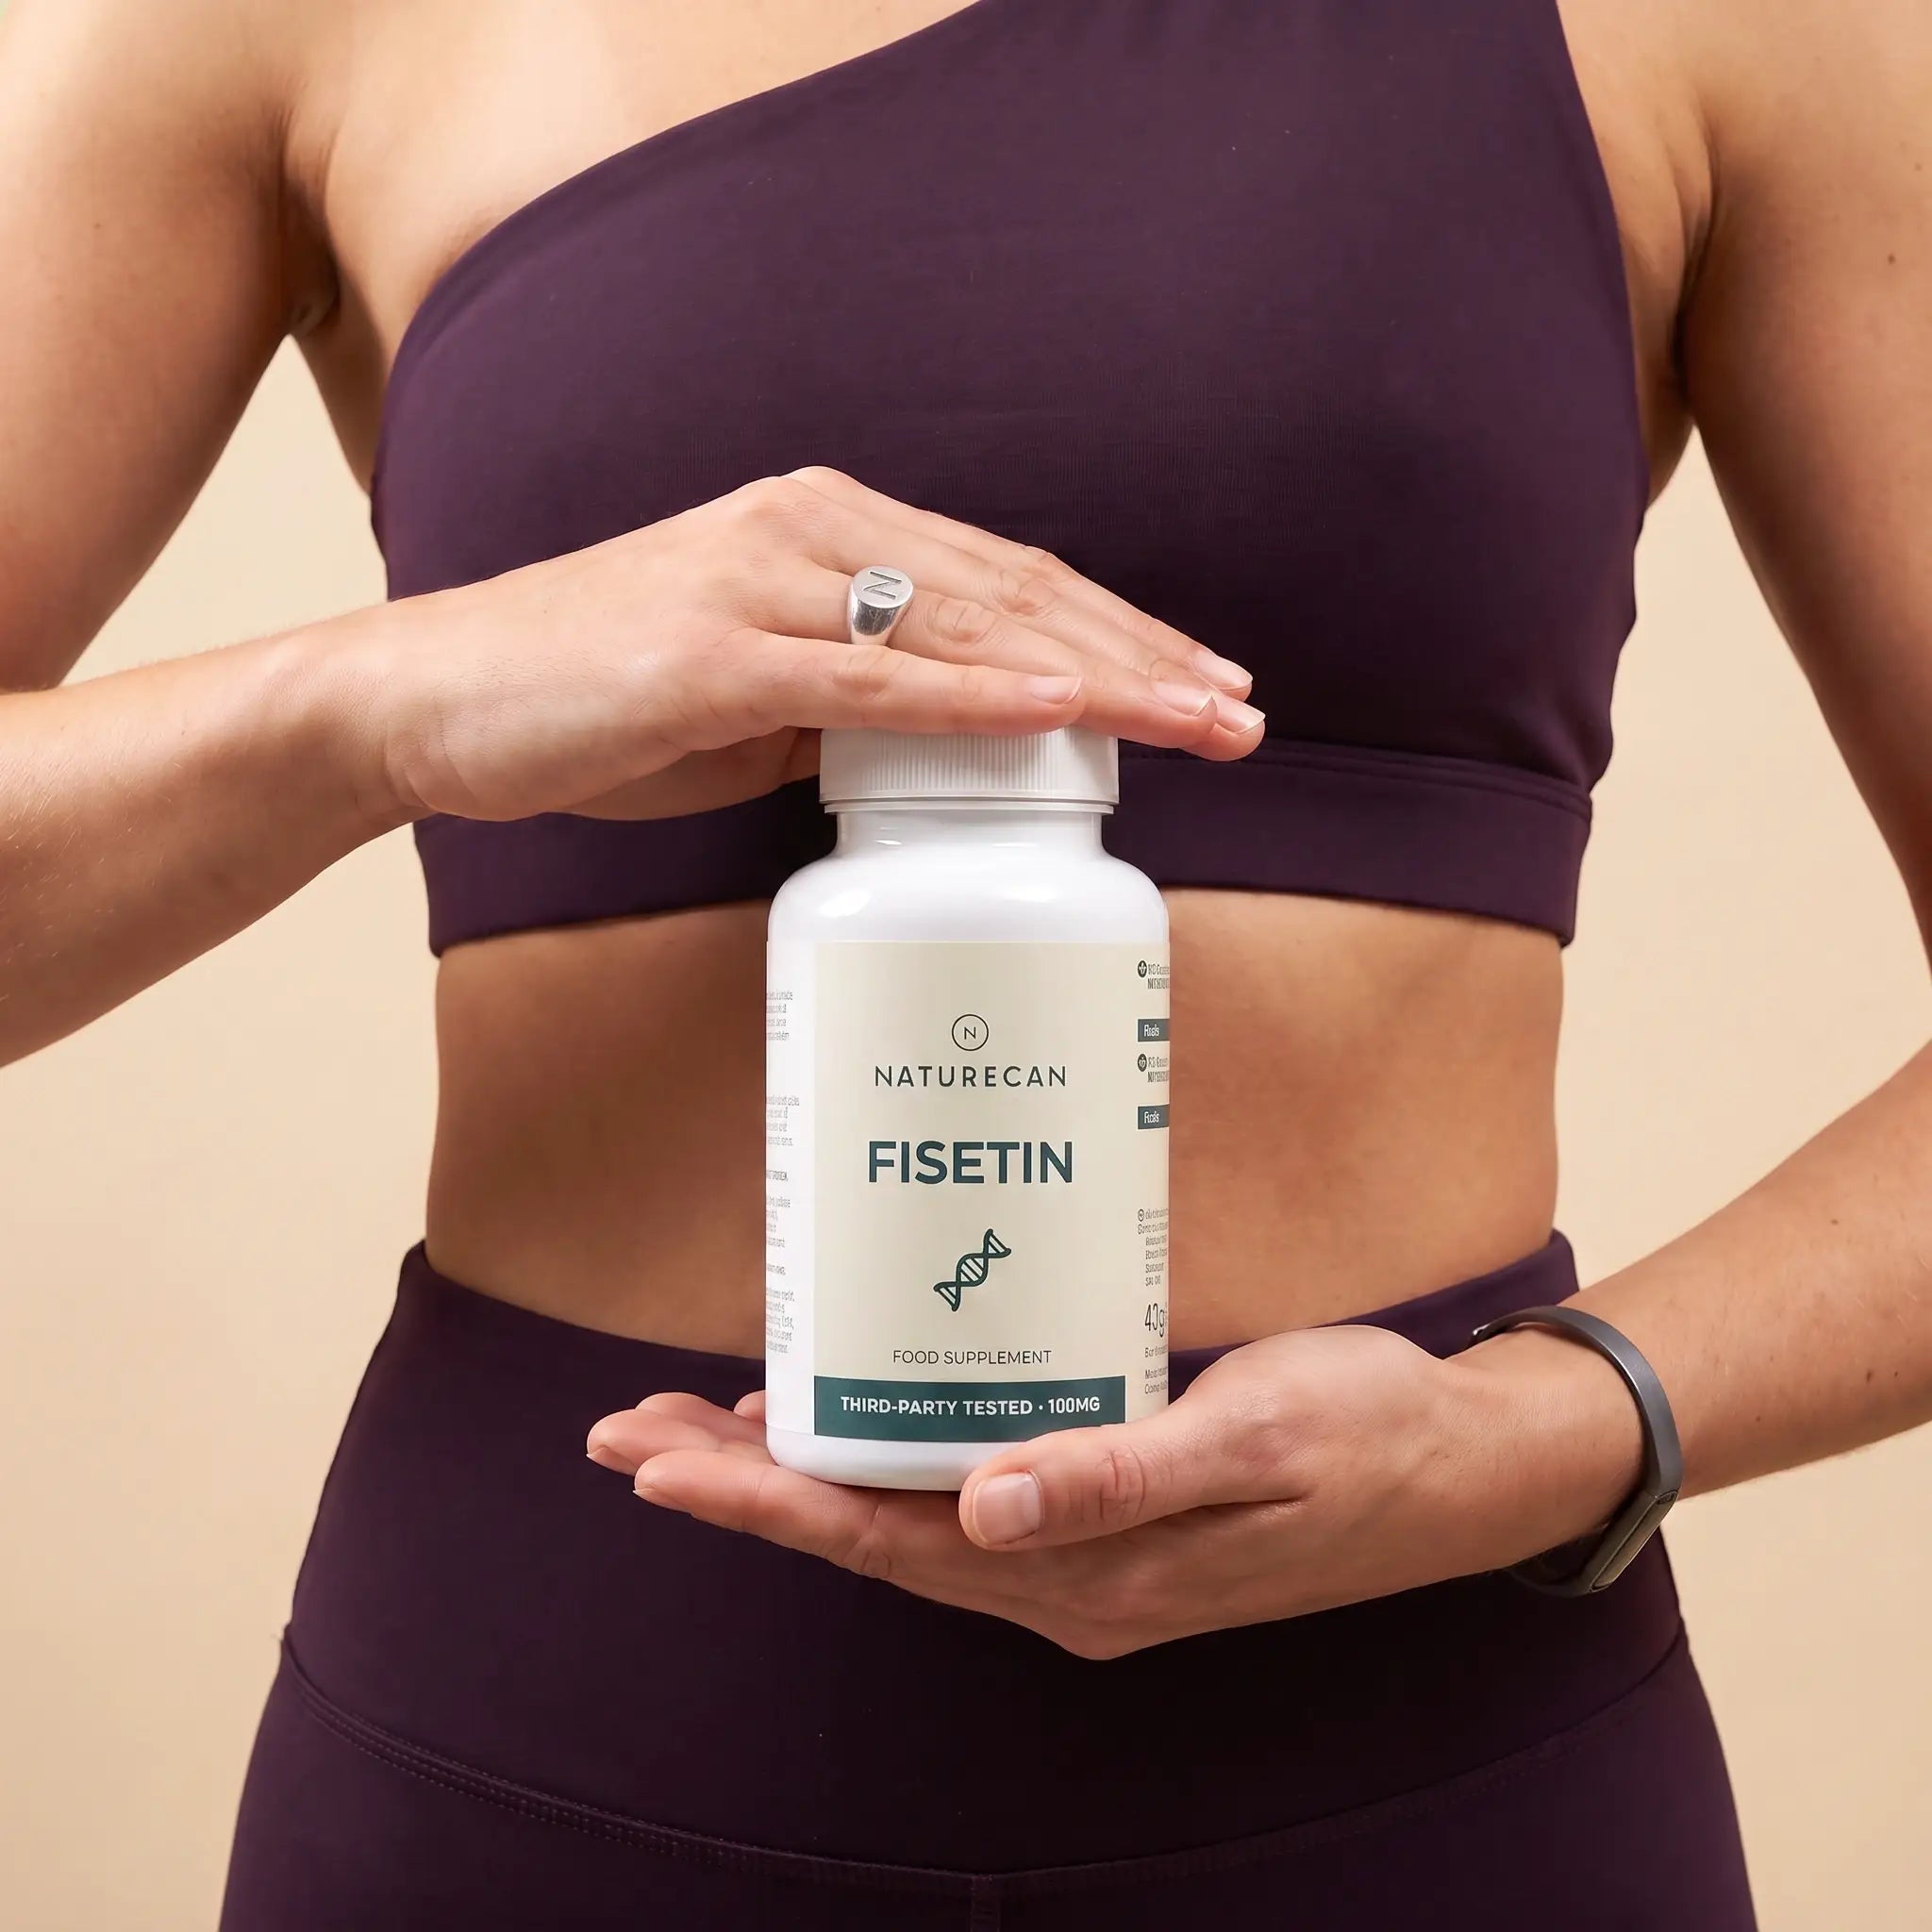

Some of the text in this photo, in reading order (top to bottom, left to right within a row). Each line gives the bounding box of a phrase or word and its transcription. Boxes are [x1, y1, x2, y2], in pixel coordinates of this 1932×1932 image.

[963, 1026, 977, 1041] N
[874, 1065, 1066, 1088] NATURECAN
[869, 1141, 1073, 1185] FISETIN
[893, 1350, 1052, 1365] FOOD SUPPLEMENT
[841, 1396, 958, 1415] THIRD-PARTY
[962, 1400, 1033, 1415] TESTED
[1047, 1396, 1101, 1414] 100MG
